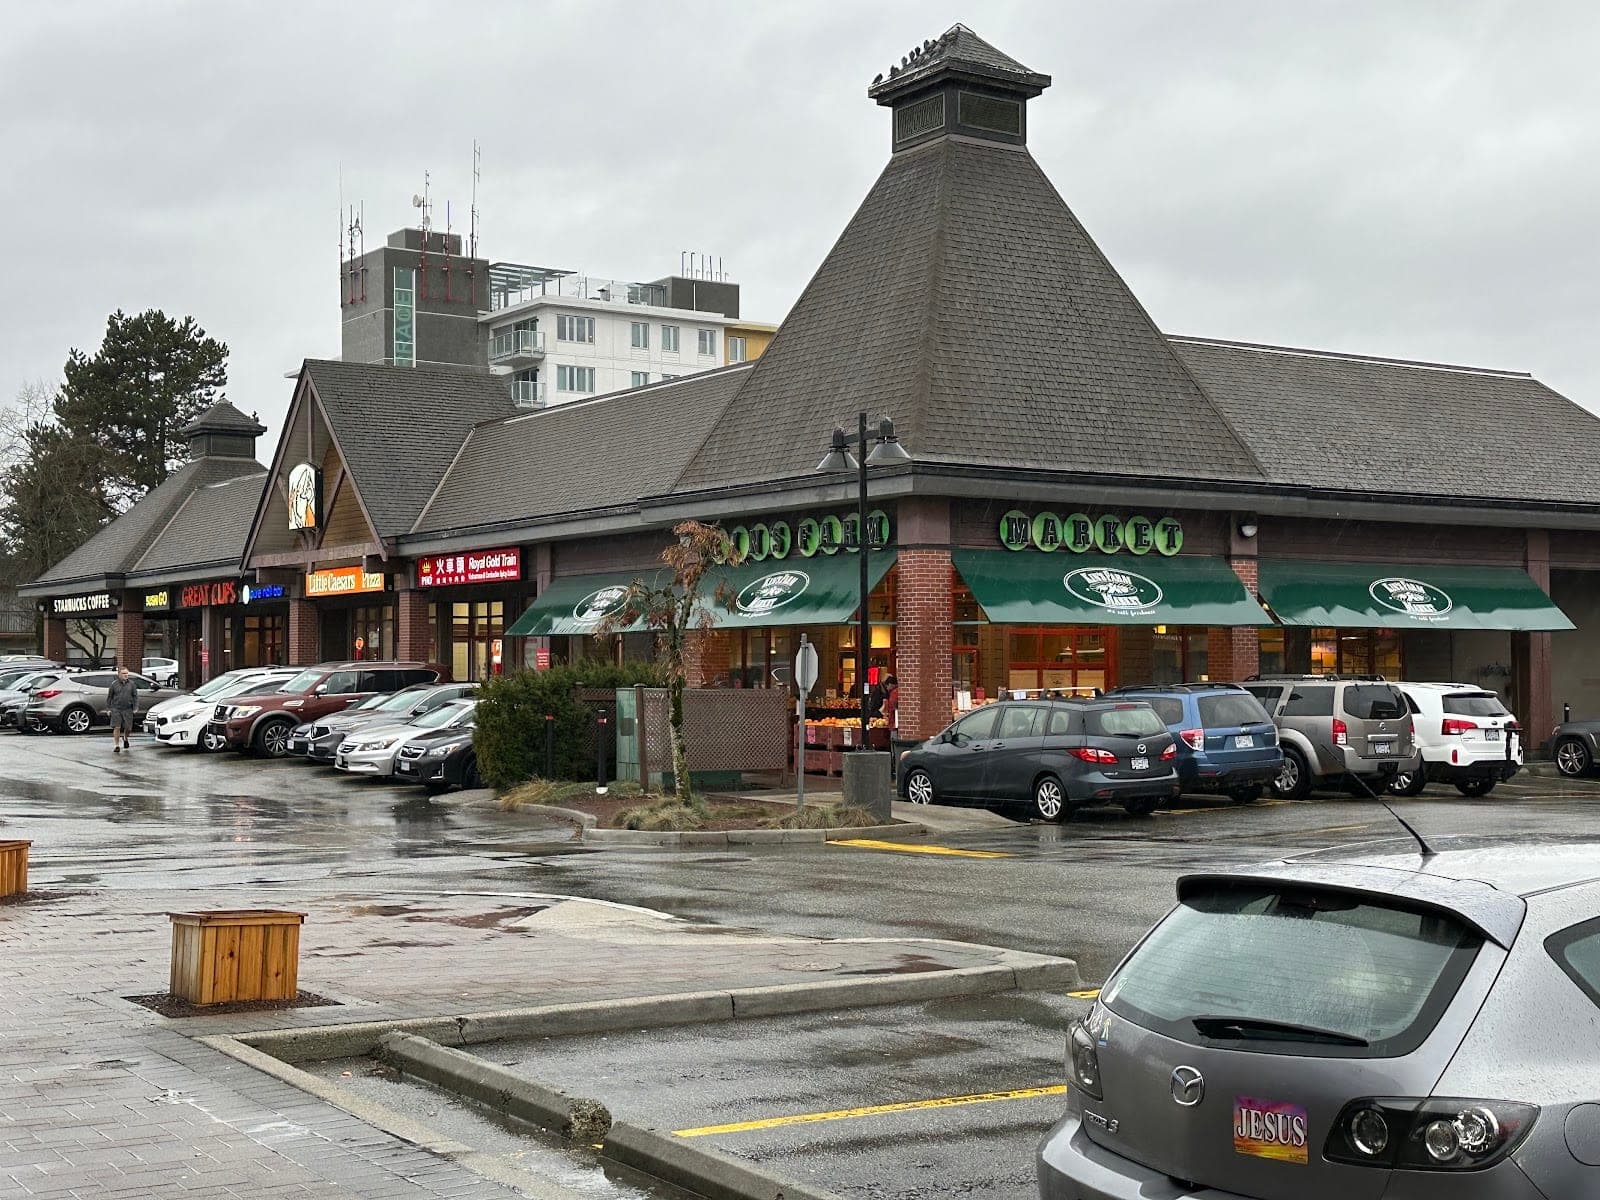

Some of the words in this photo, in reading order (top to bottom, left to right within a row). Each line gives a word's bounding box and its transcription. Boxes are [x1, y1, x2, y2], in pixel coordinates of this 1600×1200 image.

[800, 515, 884, 552] FARM
[1006, 516, 1180, 549] MARKET
[468, 556, 485, 572] Royal
[485, 554, 501, 569] Gold
[501, 553, 517, 567] Train
[309, 573, 328, 593] Little
[328, 573, 356, 592] Caesars
[362, 572, 381, 588] Pizza
[54, 596, 87, 613] STARBUCKS
[87, 594, 110, 610] COFFEE
[182, 584, 209, 607] GREAT
[1237, 1107, 1305, 1147] JESUS
